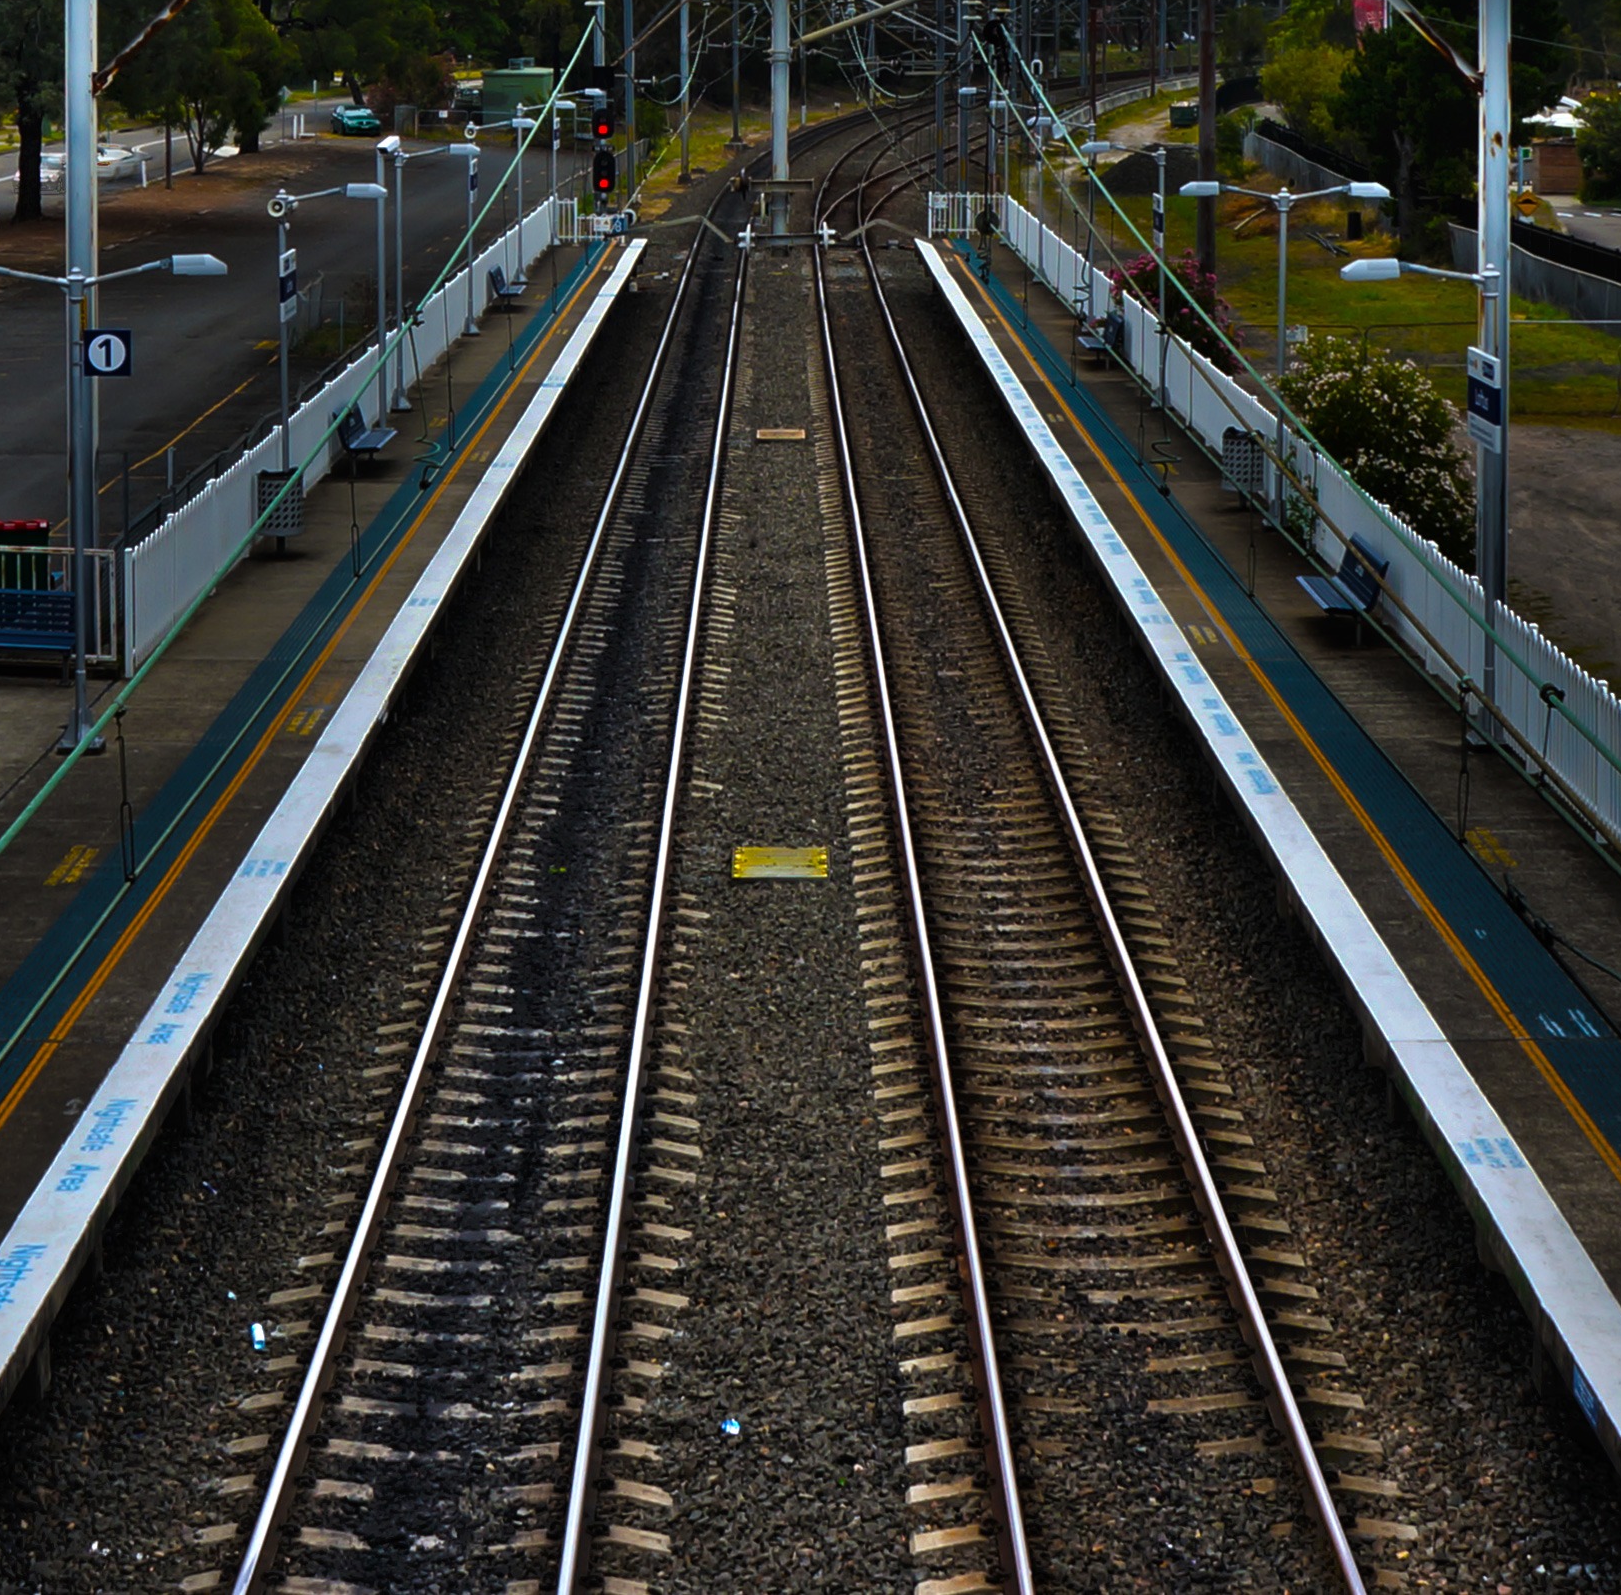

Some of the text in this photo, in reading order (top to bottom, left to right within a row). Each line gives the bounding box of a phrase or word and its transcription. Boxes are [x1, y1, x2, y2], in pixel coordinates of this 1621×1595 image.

[98, 338, 112, 367] 1
[55, 1098, 138, 1192] Nightsafe Area
